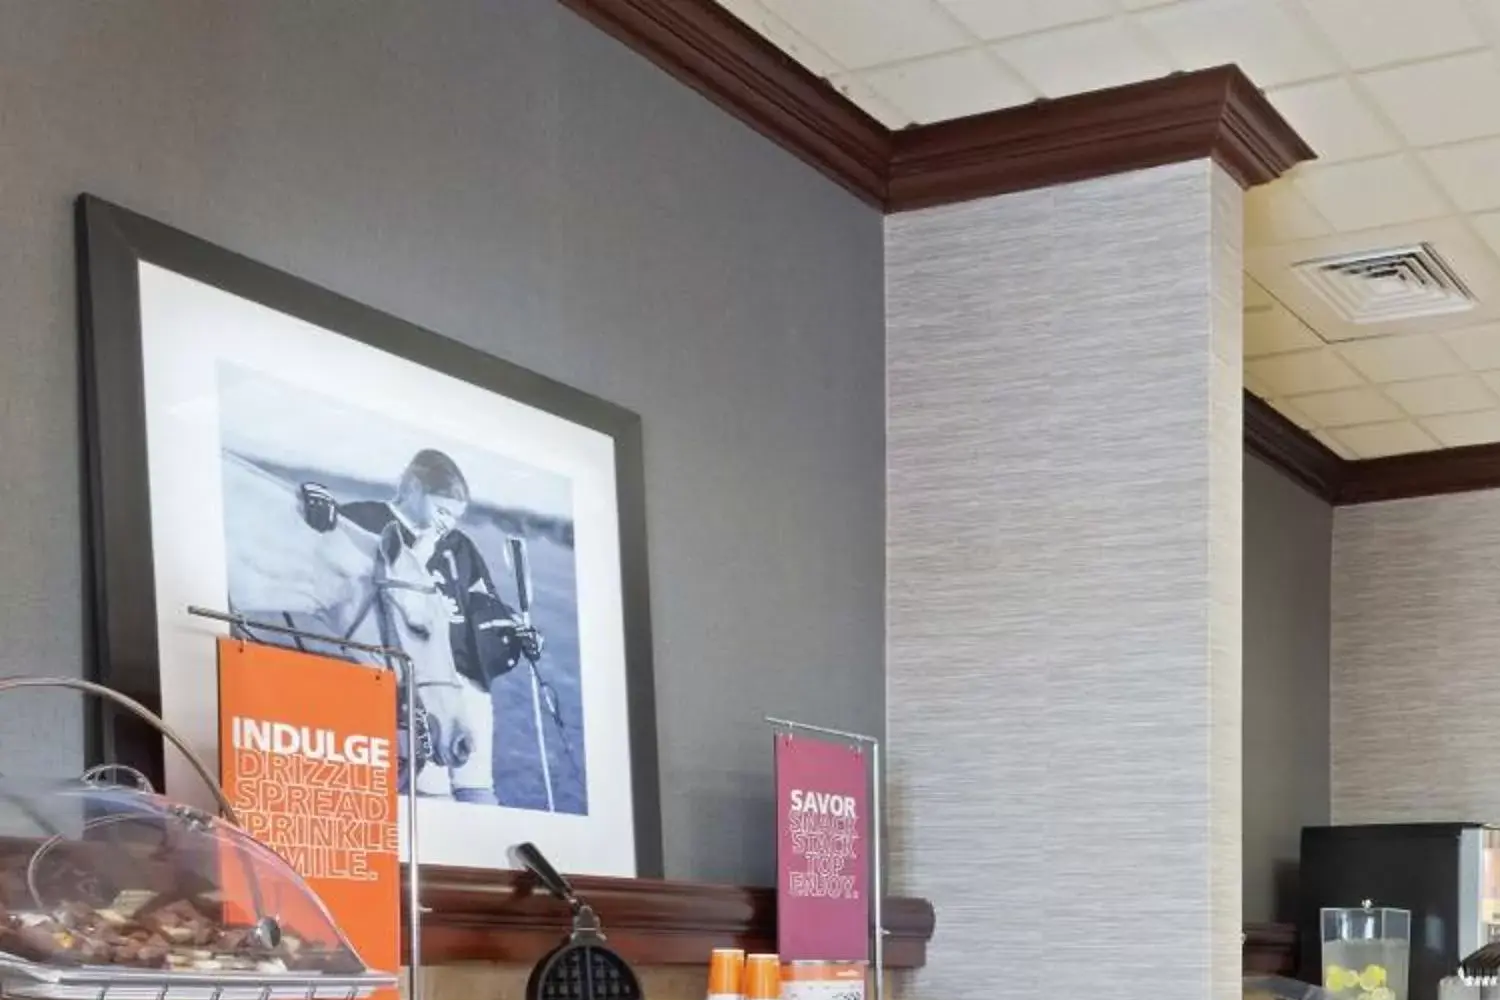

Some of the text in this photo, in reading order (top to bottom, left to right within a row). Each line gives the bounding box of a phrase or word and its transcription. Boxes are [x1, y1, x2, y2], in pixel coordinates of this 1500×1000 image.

[232, 716, 391, 768] INDULGE
[235, 750, 388, 797] DRIZZLE
[233, 778, 388, 822] SPREAD
[790, 789, 856, 819] SAVOR
[272, 845, 378, 881] MILE.
[805, 851, 845, 877] TOP
